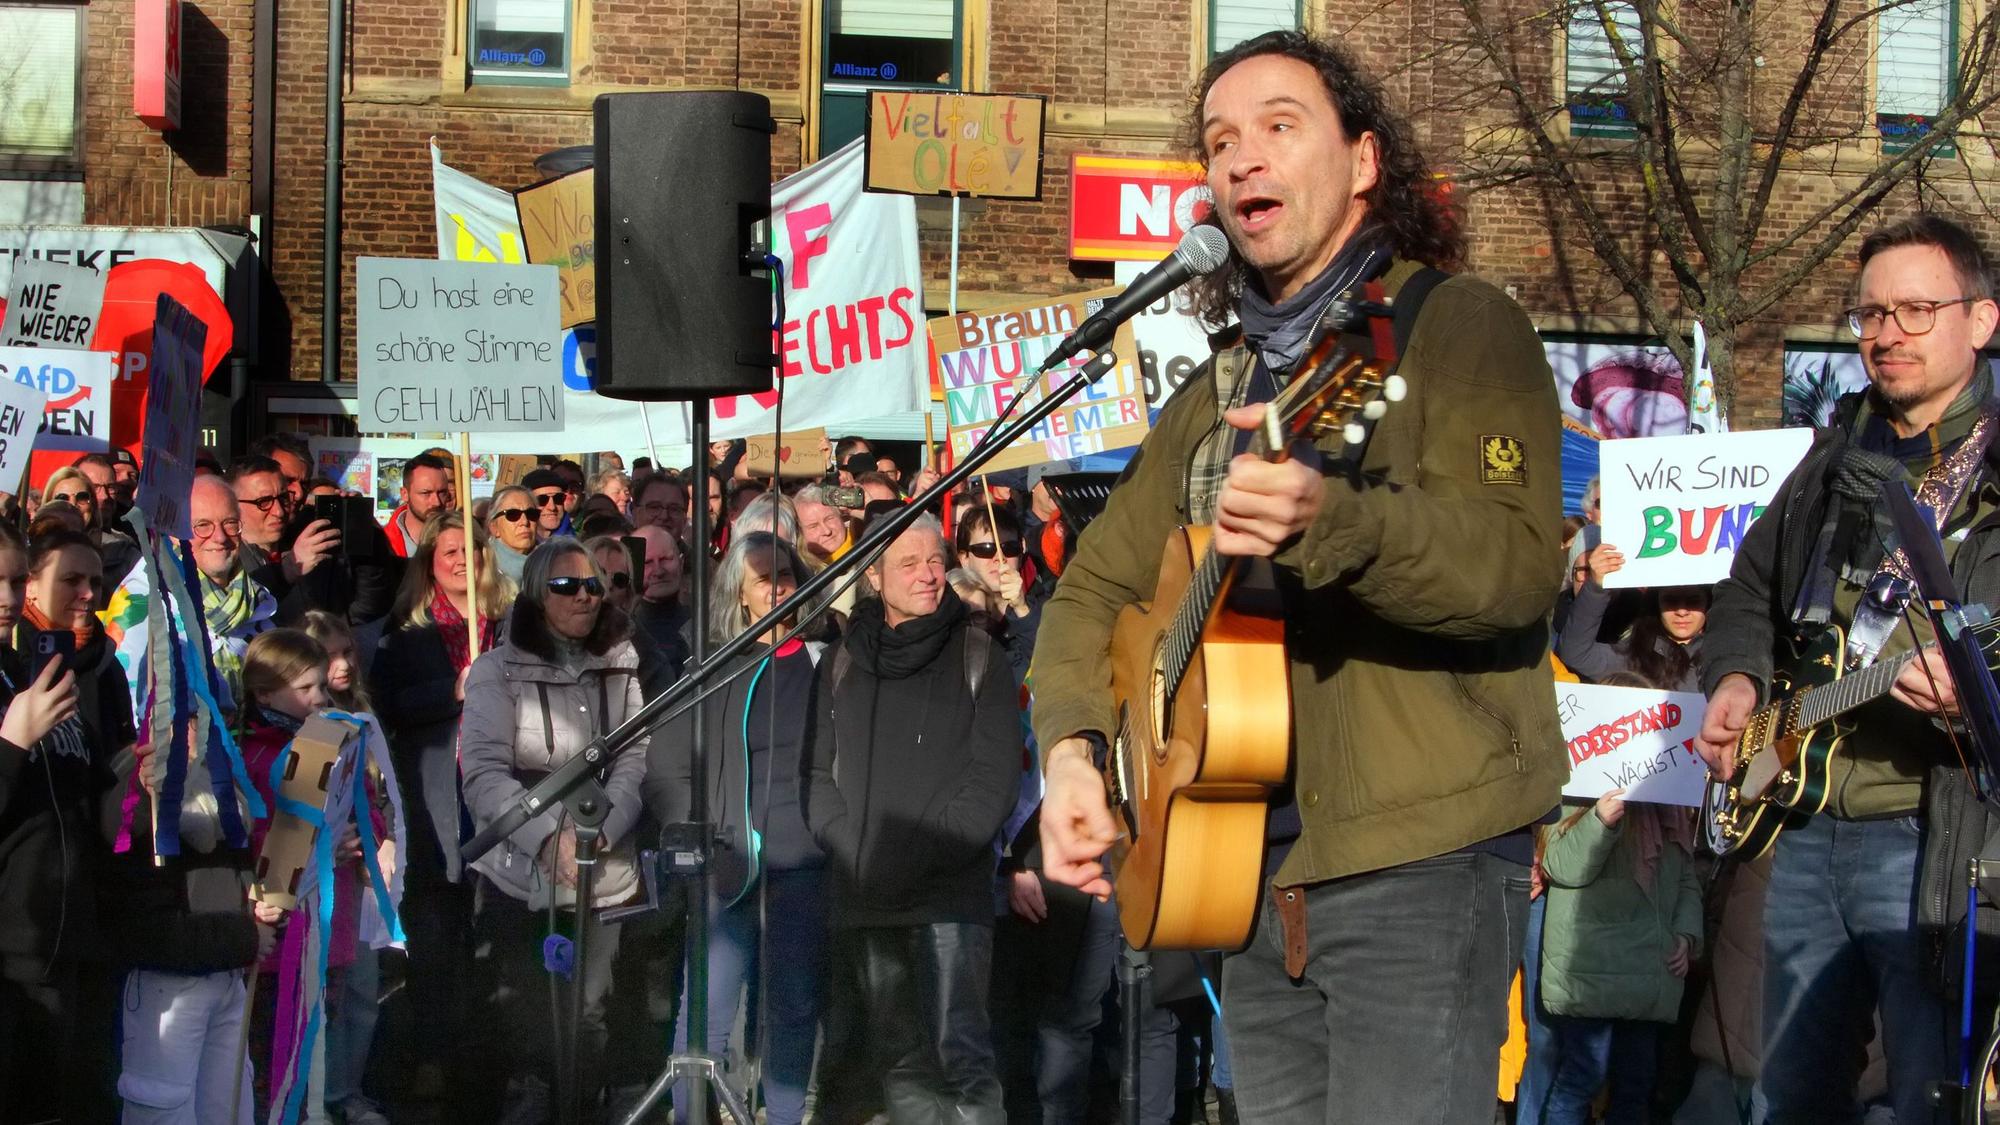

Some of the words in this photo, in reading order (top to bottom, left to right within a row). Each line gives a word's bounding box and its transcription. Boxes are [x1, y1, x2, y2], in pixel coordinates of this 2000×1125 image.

[479, 48, 525, 62] Allianz
[832, 63, 878, 77] Allianz
[880, 94, 1026, 147] Vielfalt
[19, 284, 61, 312] NIE
[378, 277, 418, 310] Du
[432, 277, 481, 310] hast
[493, 282, 534, 307] eine
[20, 312, 91, 346] WIEDER
[955, 303, 1079, 348] Braun
[376, 332, 456, 363] schöne
[465, 329, 552, 363] Stimme
[15, 364, 76, 394] AfD
[374, 386, 439, 424] GEH
[449, 385, 556, 424] WÄHLEN
[1073, 398, 1140, 432] MER
[202, 429, 217, 447] 11
[749, 443, 770, 461] Die
[1046, 431, 1102, 460] NET
[1626, 458, 1683, 492] WIR
[1691, 455, 1770, 491] SIND
[1557, 693, 1586, 725] ER
[1567, 700, 1682, 771] IDERSTAND
[1603, 746, 1679, 789] WÄCHST
